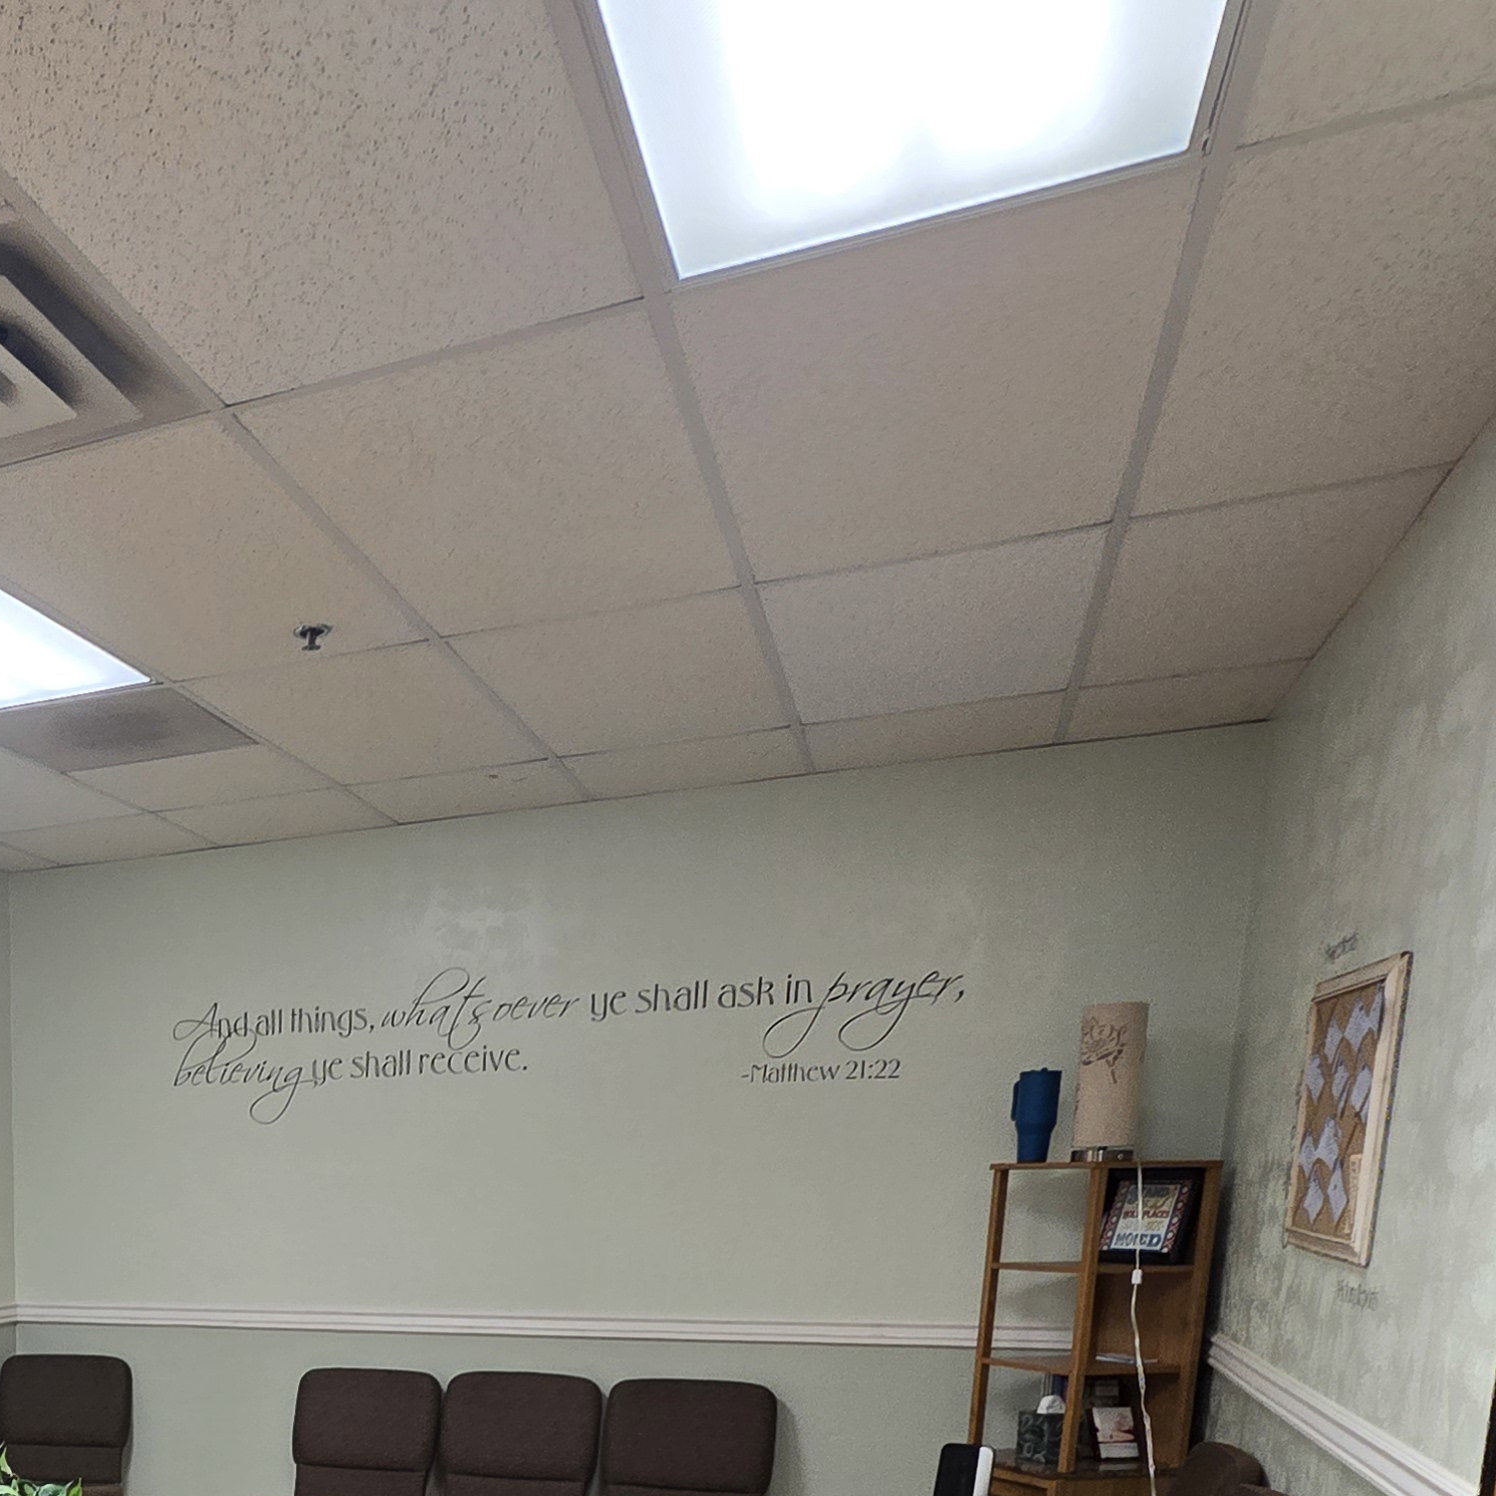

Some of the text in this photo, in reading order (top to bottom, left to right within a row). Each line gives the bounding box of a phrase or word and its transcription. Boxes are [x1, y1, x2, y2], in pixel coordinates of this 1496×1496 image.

[634, 979, 708, 1015] shall
[716, 975, 775, 1008] ask
[785, 972, 812, 1005] in
[172, 1002, 248, 1040] And
[256, 1008, 283, 1037] all
[290, 1005, 375, 1037] things,
[590, 989, 628, 1023] ye
[762, 970, 966, 1059] prayer,
[312, 1057, 343, 1087] ye
[350, 1048, 411, 1080] shall
[418, 1044, 528, 1075] receive.
[845, 1058, 901, 1081] 21:22
